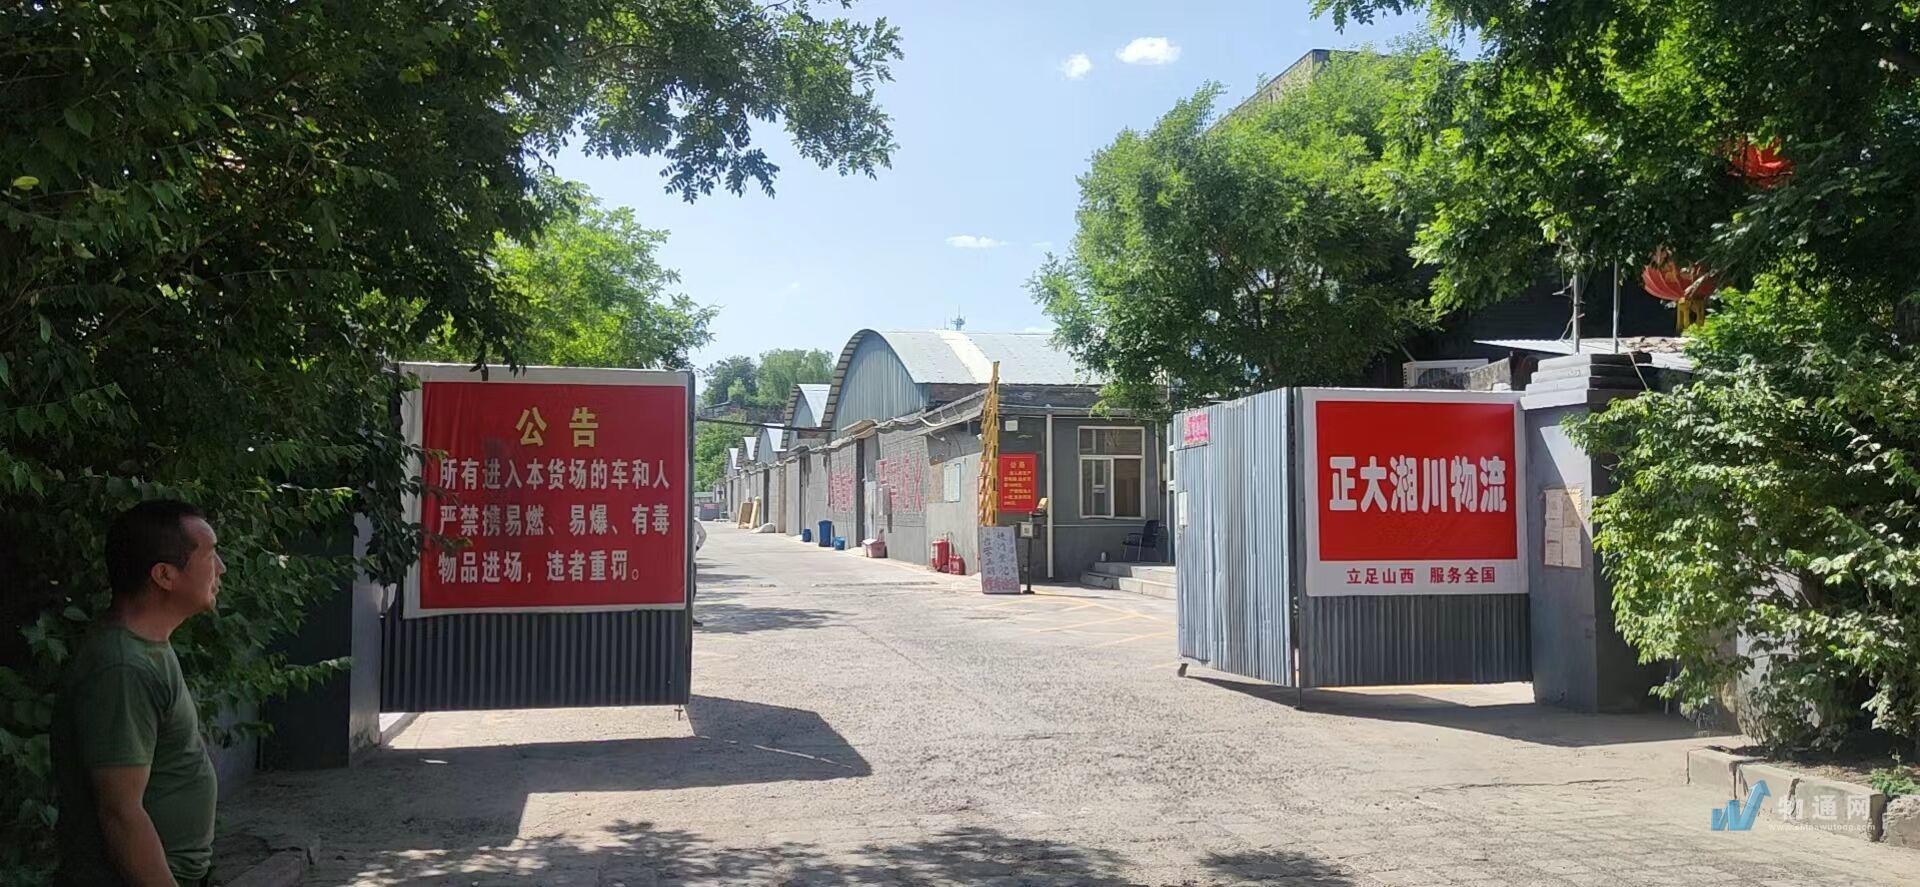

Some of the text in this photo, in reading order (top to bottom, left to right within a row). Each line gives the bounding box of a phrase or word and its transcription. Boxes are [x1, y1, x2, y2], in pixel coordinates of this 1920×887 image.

[515, 406, 600, 448] 公告
[439, 457, 671, 490] 所有进入本货场的车和人
[1328, 454, 1507, 514] 正大湘川物流
[438, 503, 671, 537] 严禁携易燃、易爆、有毒
[438, 549, 640, 584] 物品进场，违者重罚。
[1346, 566, 1496, 584] 立足山西 服务全国
